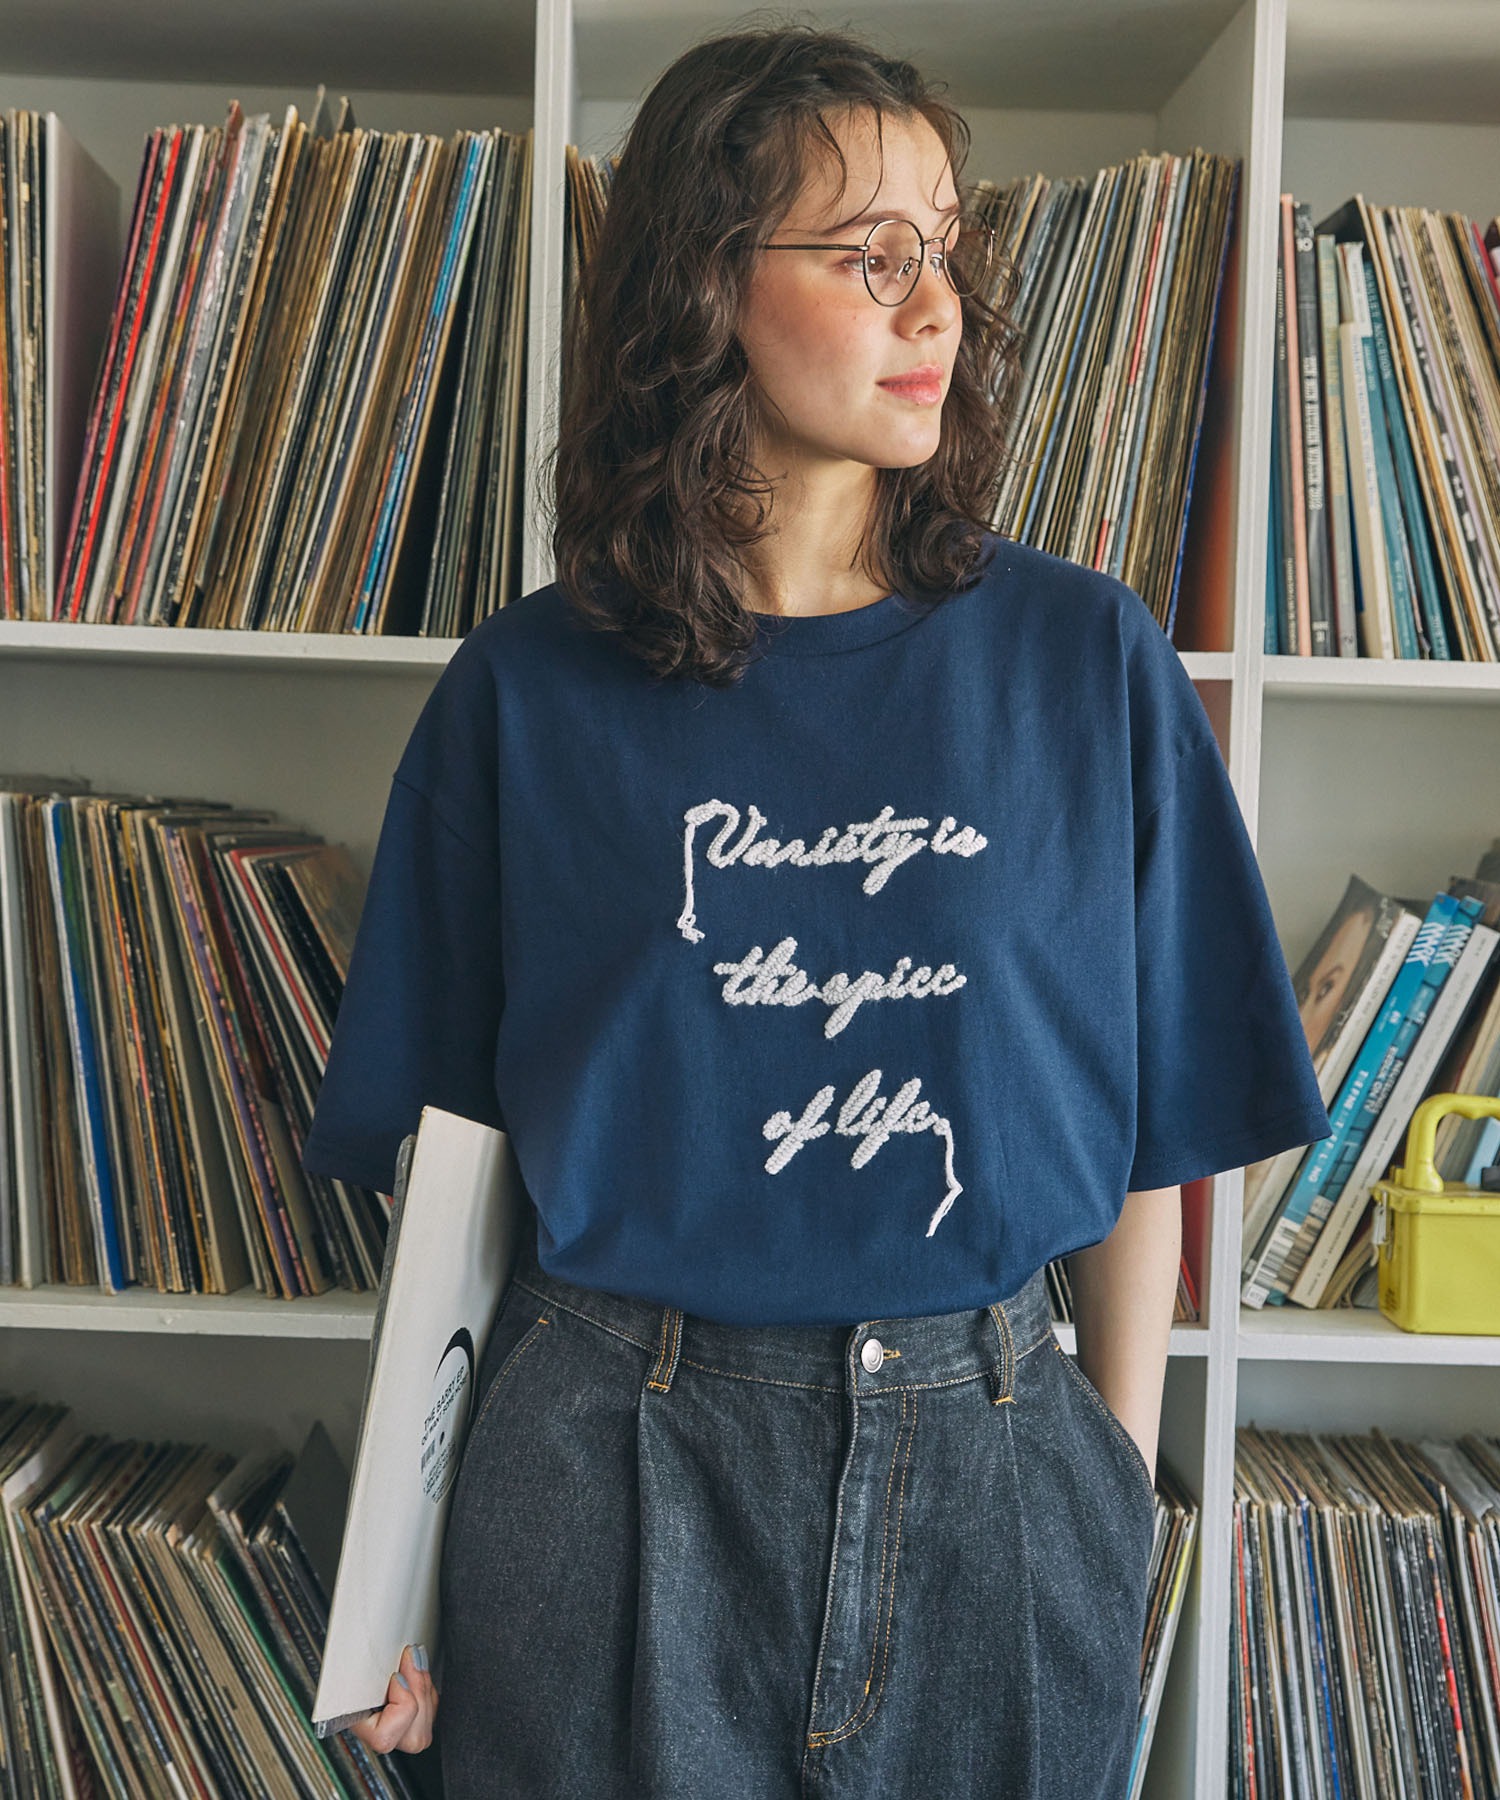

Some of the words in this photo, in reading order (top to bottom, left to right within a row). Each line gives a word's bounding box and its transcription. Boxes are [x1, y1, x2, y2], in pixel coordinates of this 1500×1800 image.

[684, 799, 929, 895] Variety
[931, 816, 988, 858] is
[713, 936, 818, 1006] the
[822, 957, 967, 1039] spice
[763, 1085, 835, 1174] of
[835, 1069, 938, 1170] life
